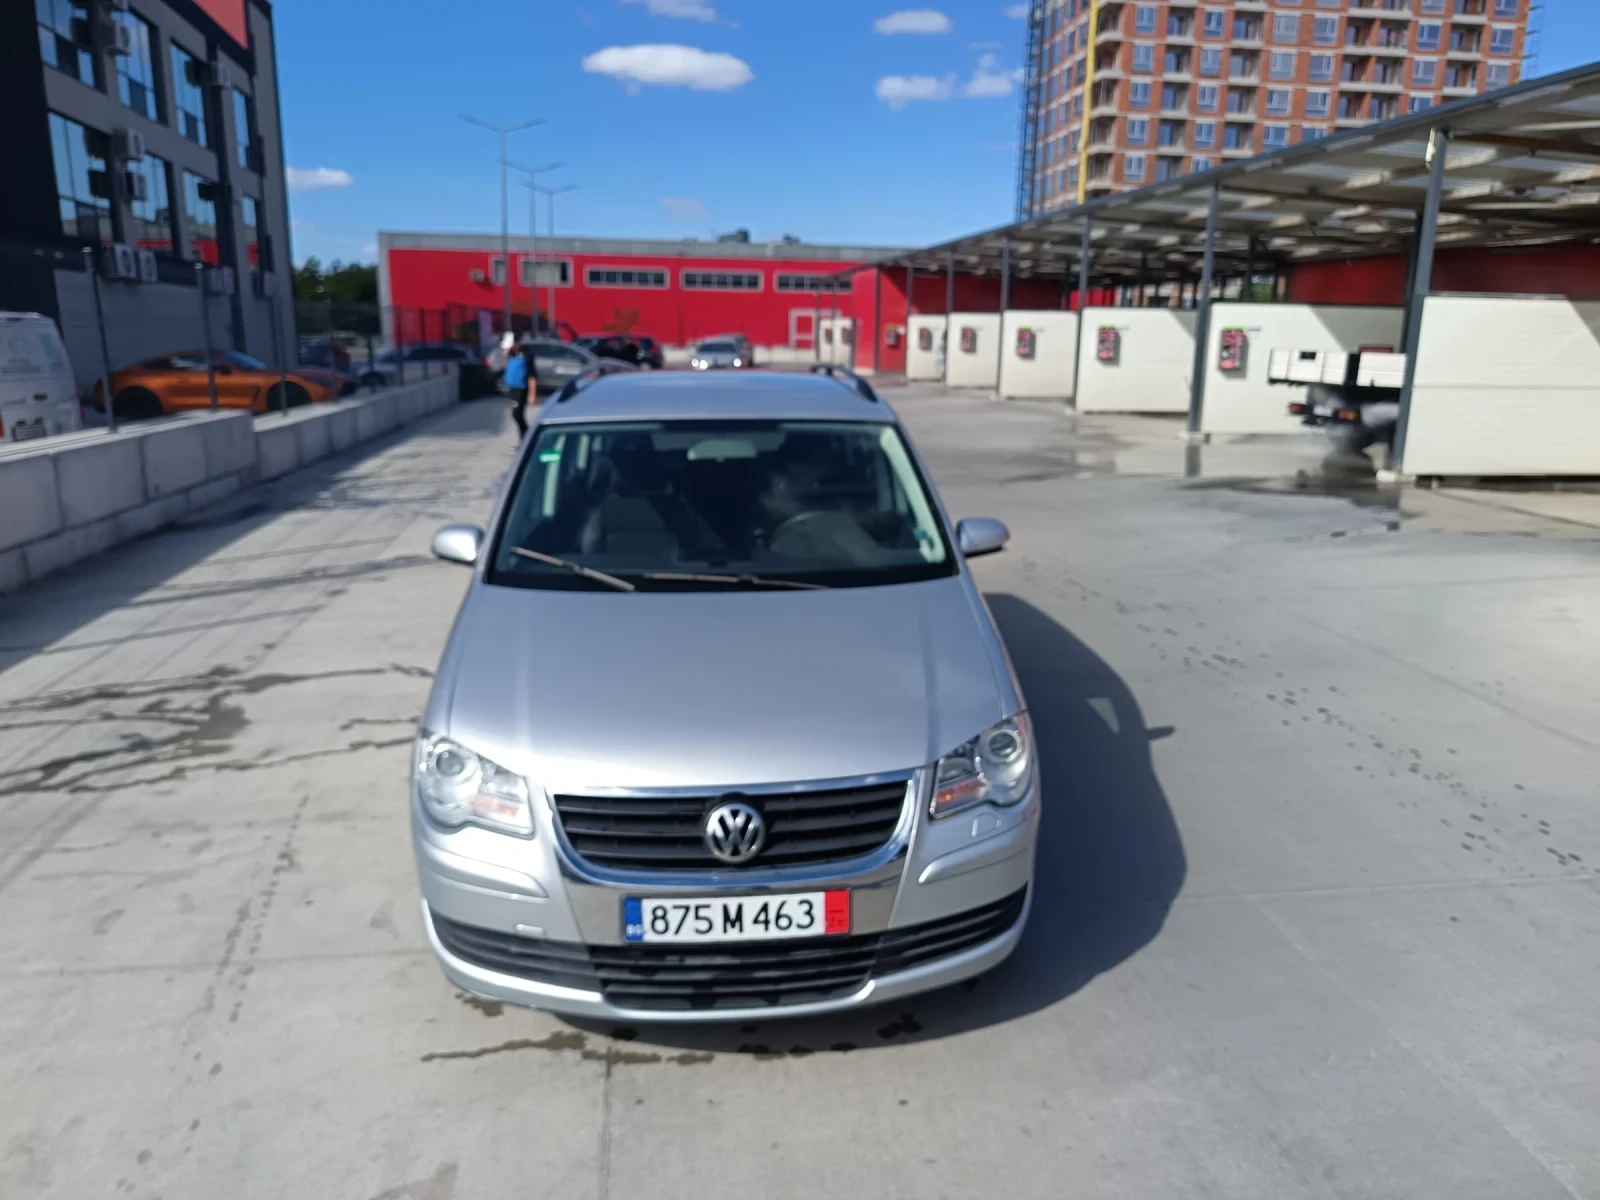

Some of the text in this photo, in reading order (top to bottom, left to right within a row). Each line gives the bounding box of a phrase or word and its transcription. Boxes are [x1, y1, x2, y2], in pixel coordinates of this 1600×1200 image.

[708, 804, 761, 861] VW
[650, 899, 815, 936] 875 M 463
